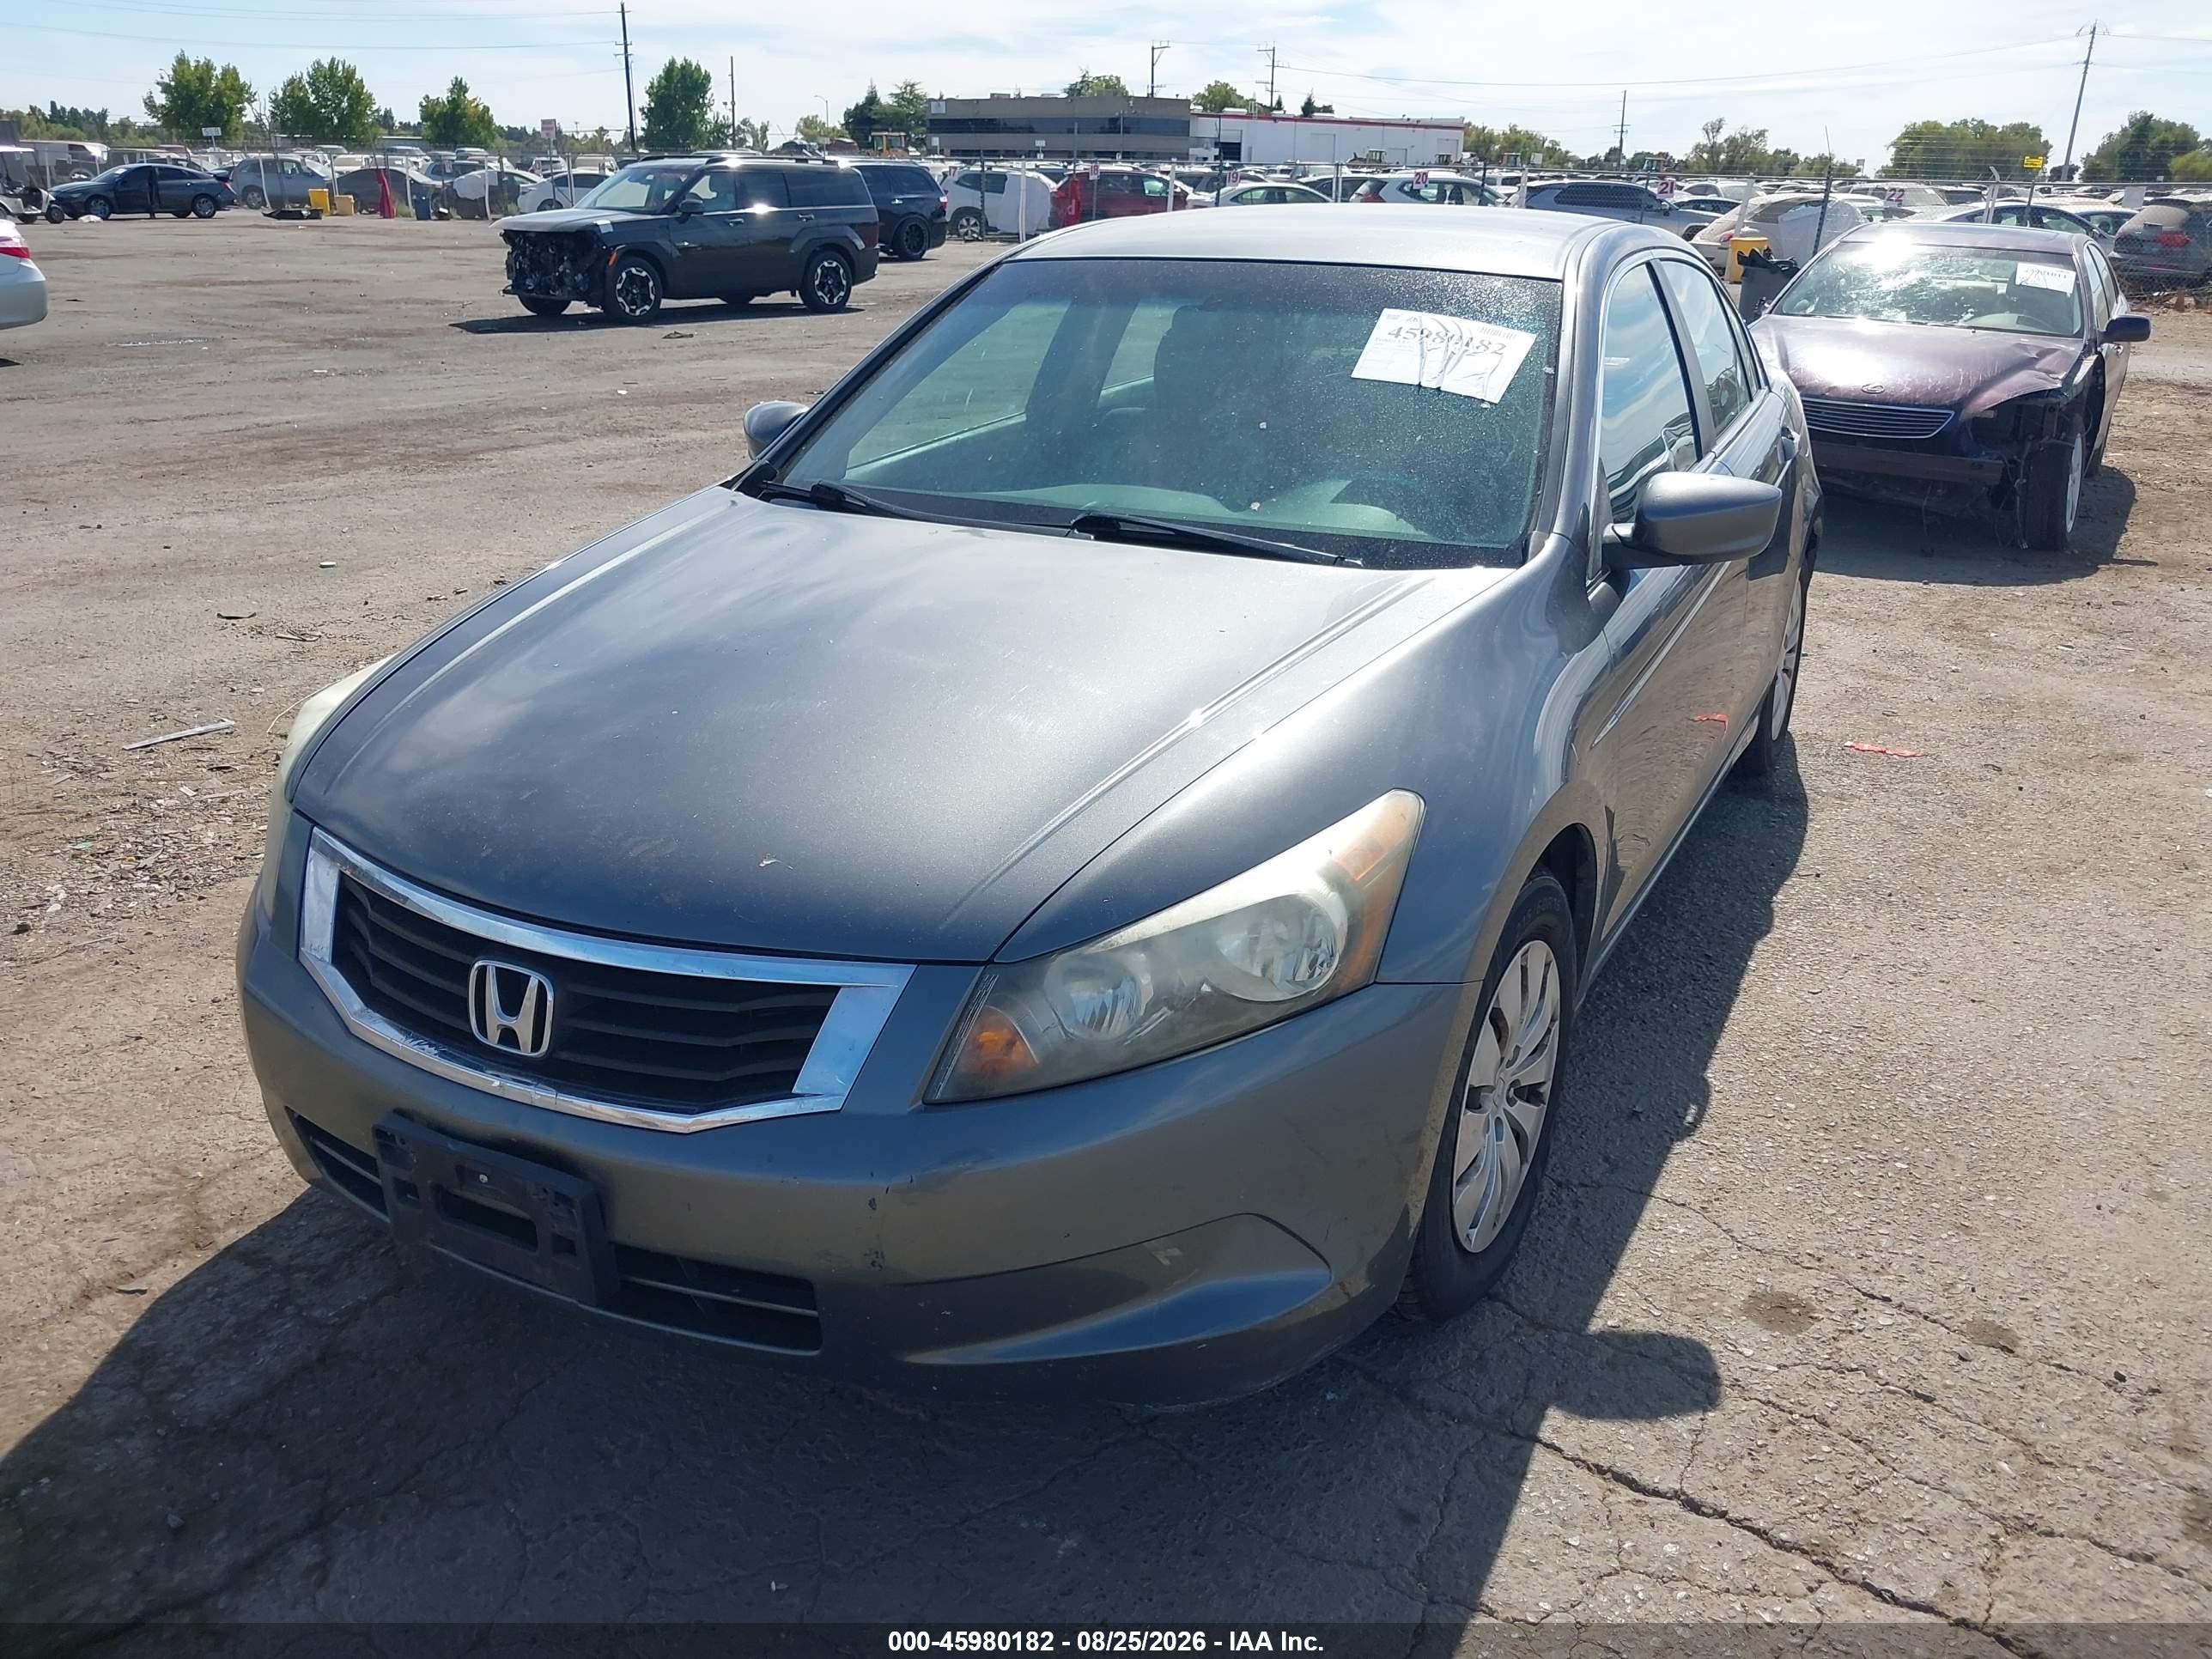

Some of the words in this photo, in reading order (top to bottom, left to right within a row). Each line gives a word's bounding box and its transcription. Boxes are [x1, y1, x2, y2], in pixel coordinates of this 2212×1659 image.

[1091, 165, 1099, 176] 18
[1228, 172, 1238, 183] 19
[1415, 172, 1428, 185] 20
[1658, 181, 1674, 194] 21
[1887, 188, 1905, 202] 22
